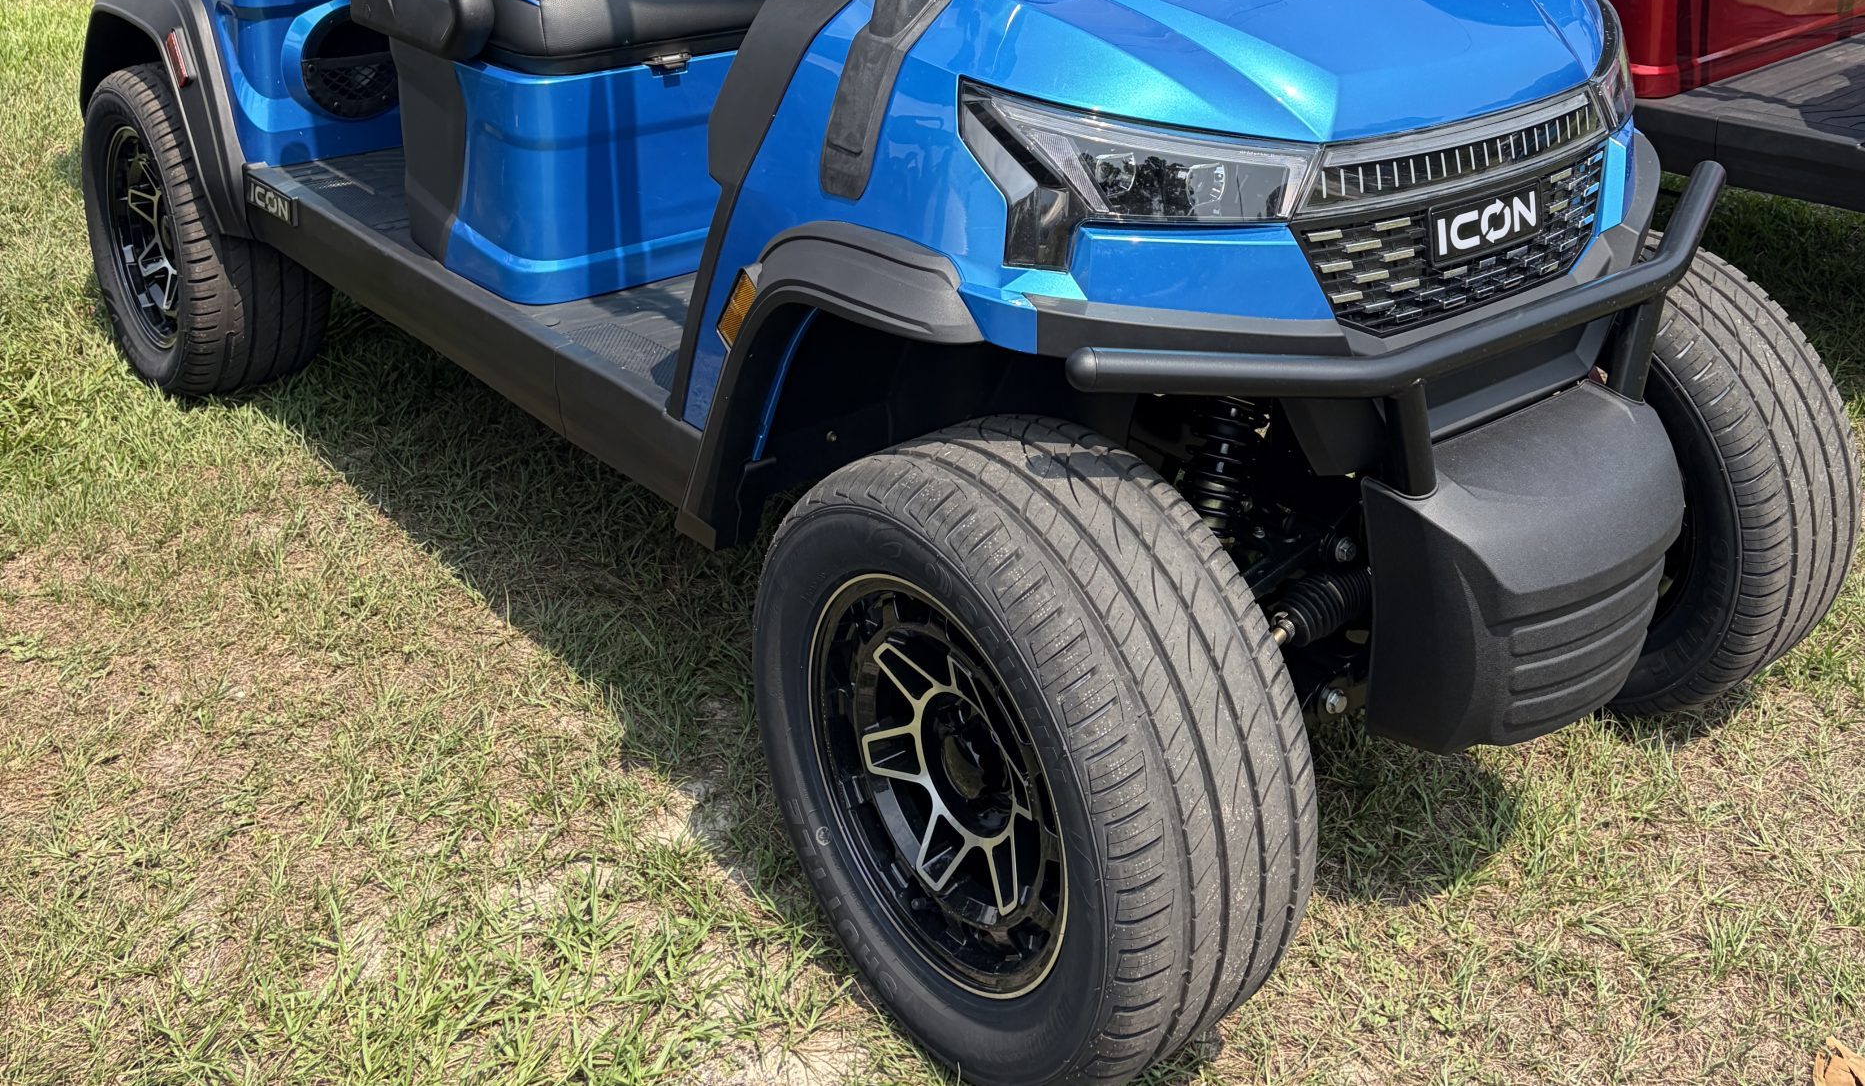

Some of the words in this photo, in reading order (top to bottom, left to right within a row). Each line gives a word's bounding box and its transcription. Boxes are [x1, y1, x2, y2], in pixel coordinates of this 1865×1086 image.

[251, 183, 288, 221] ICON
[1437, 190, 1537, 256] ICON
[784, 798, 898, 1002] SHUTTLE
